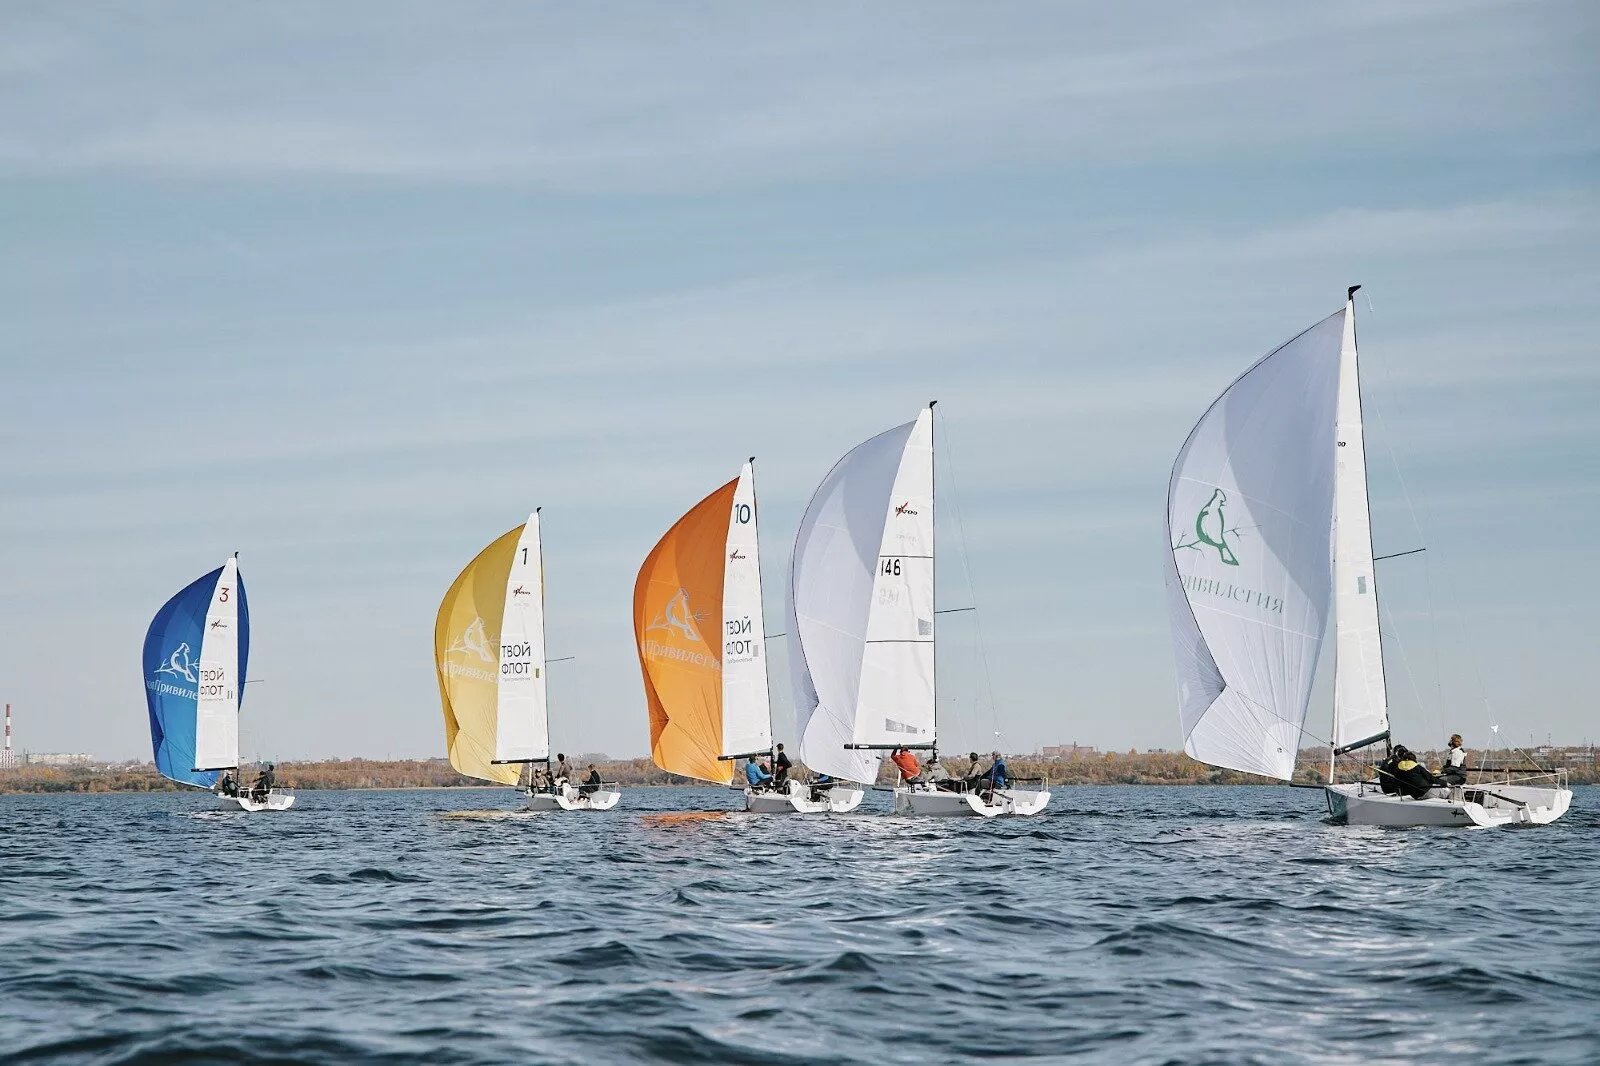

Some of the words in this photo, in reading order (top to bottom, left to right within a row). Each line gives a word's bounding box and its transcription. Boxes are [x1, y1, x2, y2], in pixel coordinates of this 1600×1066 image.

[735, 503, 750, 524] 10
[522, 547, 528, 565] 1
[881, 559, 901, 576] 146
[219, 587, 230, 603] 3
[726, 615, 752, 635] ТВОЙ
[501, 641, 531, 658] ТВОЙ
[200, 667, 224, 681] ТВОЙ
[501, 662, 531, 675] ФЛОТ
